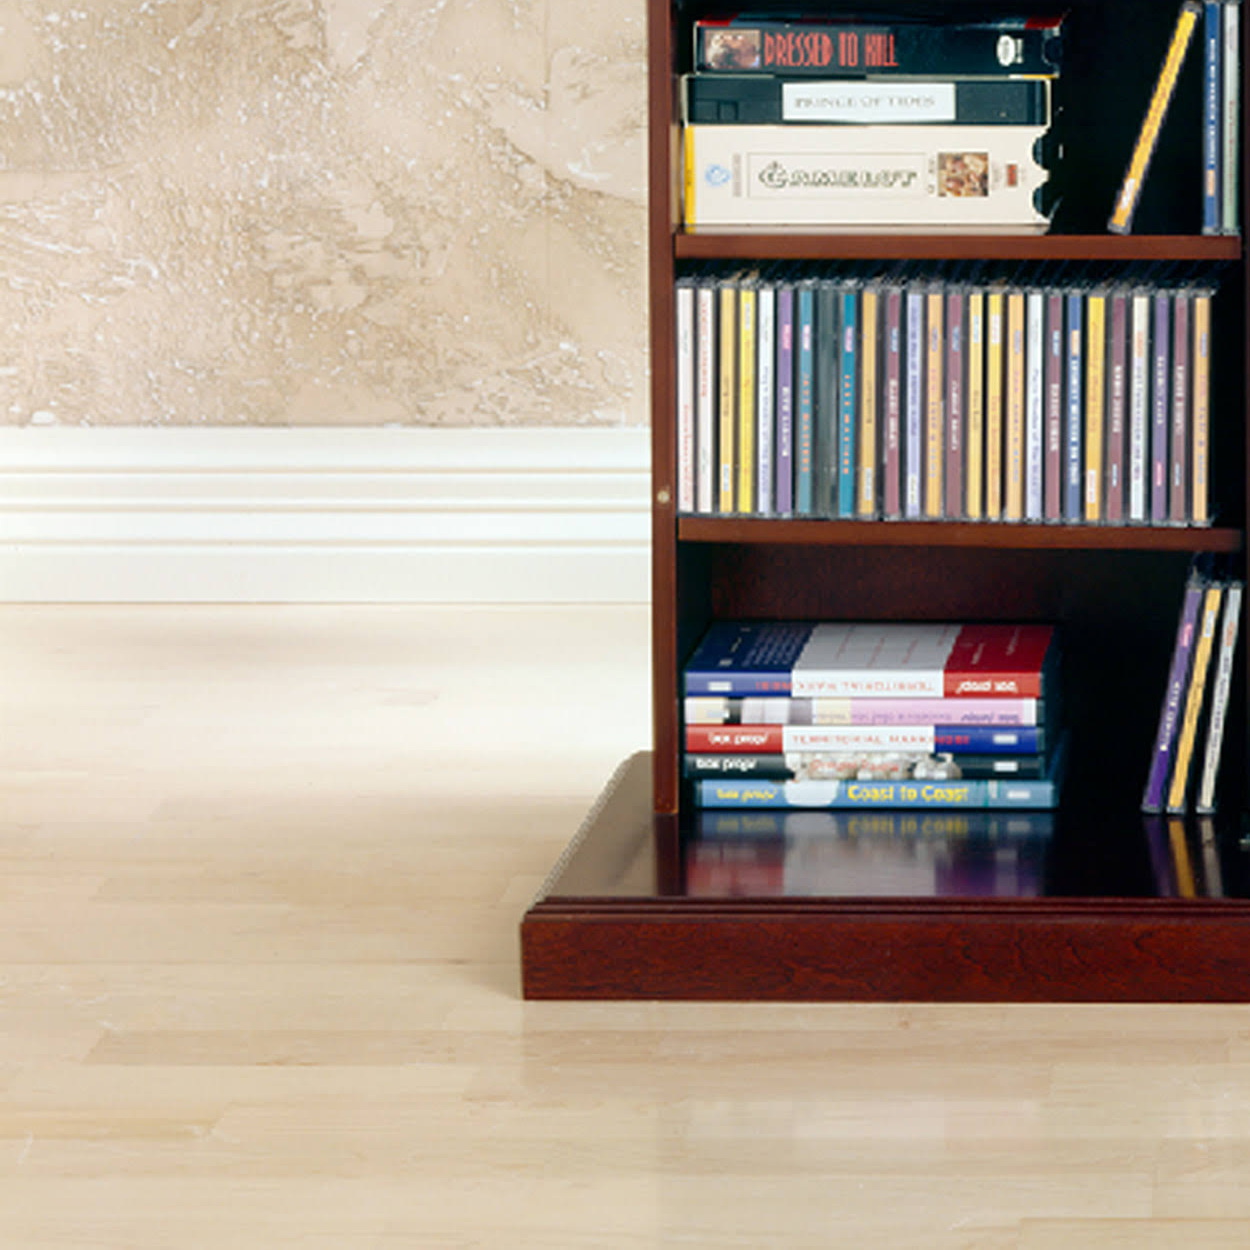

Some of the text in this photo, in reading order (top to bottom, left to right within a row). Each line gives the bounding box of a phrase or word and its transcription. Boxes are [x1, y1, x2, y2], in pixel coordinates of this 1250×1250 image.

[764, 32, 898, 67] DRESSED TO KILL
[794, 95, 856, 108] PRINCE
[847, 786, 969, 802] Coast to Coast
